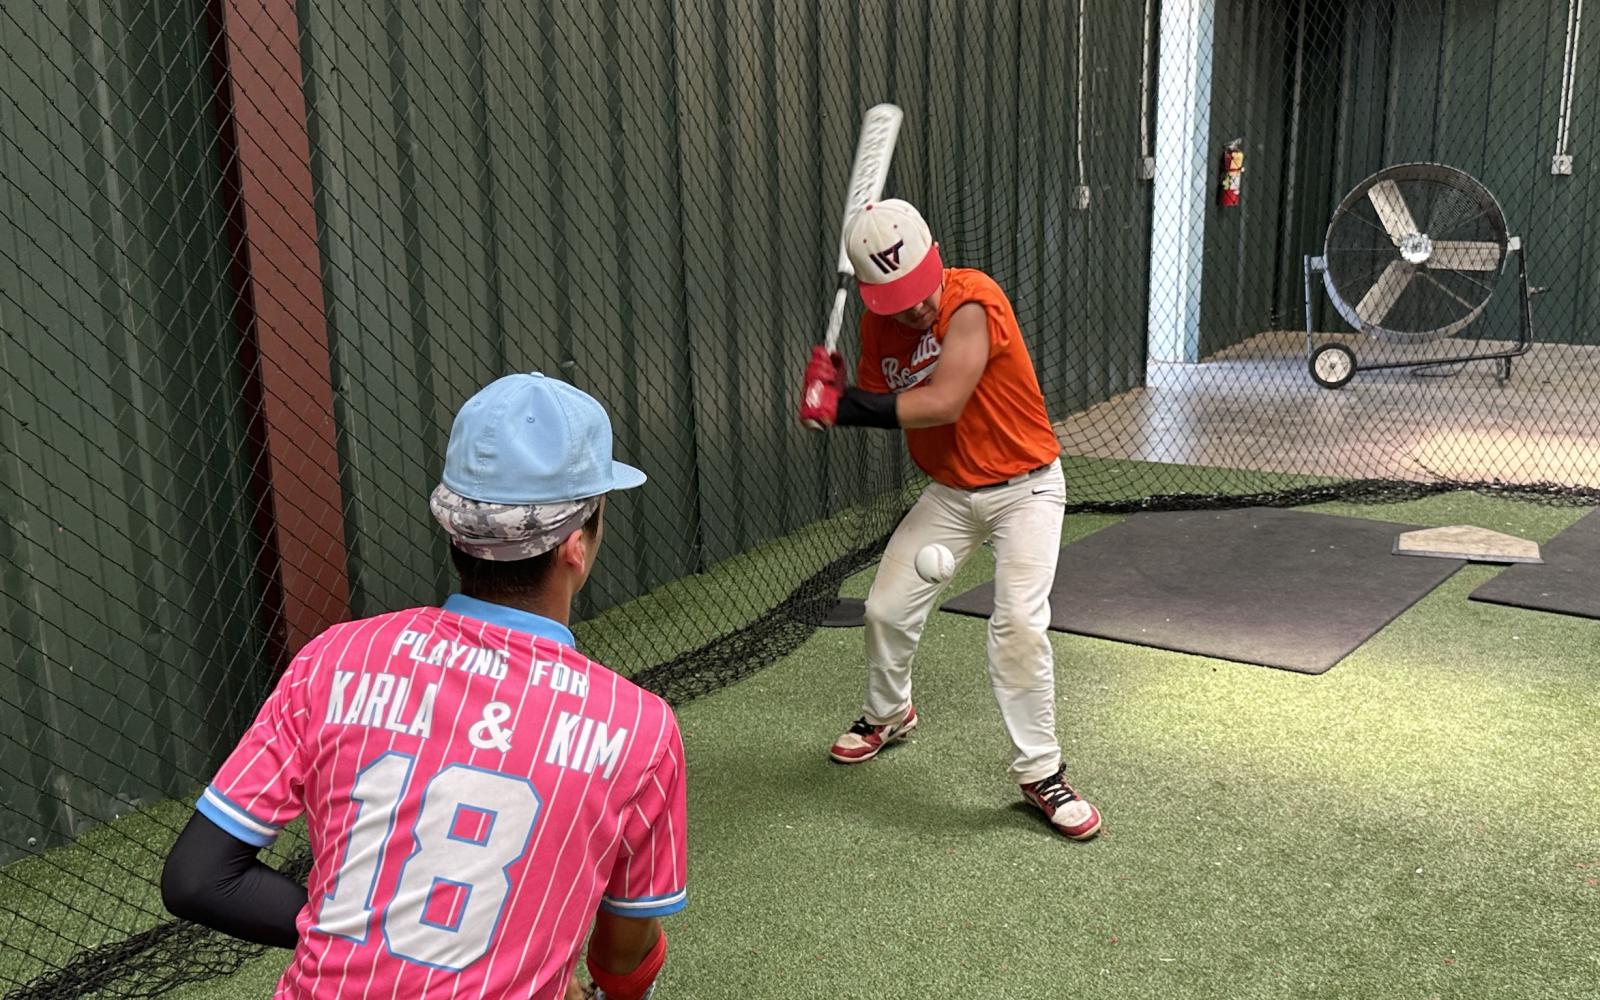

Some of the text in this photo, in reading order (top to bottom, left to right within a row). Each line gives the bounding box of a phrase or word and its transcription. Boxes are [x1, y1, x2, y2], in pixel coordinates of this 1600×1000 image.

[392, 629, 589, 698] PLAYING FOR
[325, 670, 628, 780] KARLA & KIM
[311, 751, 542, 973] 18
